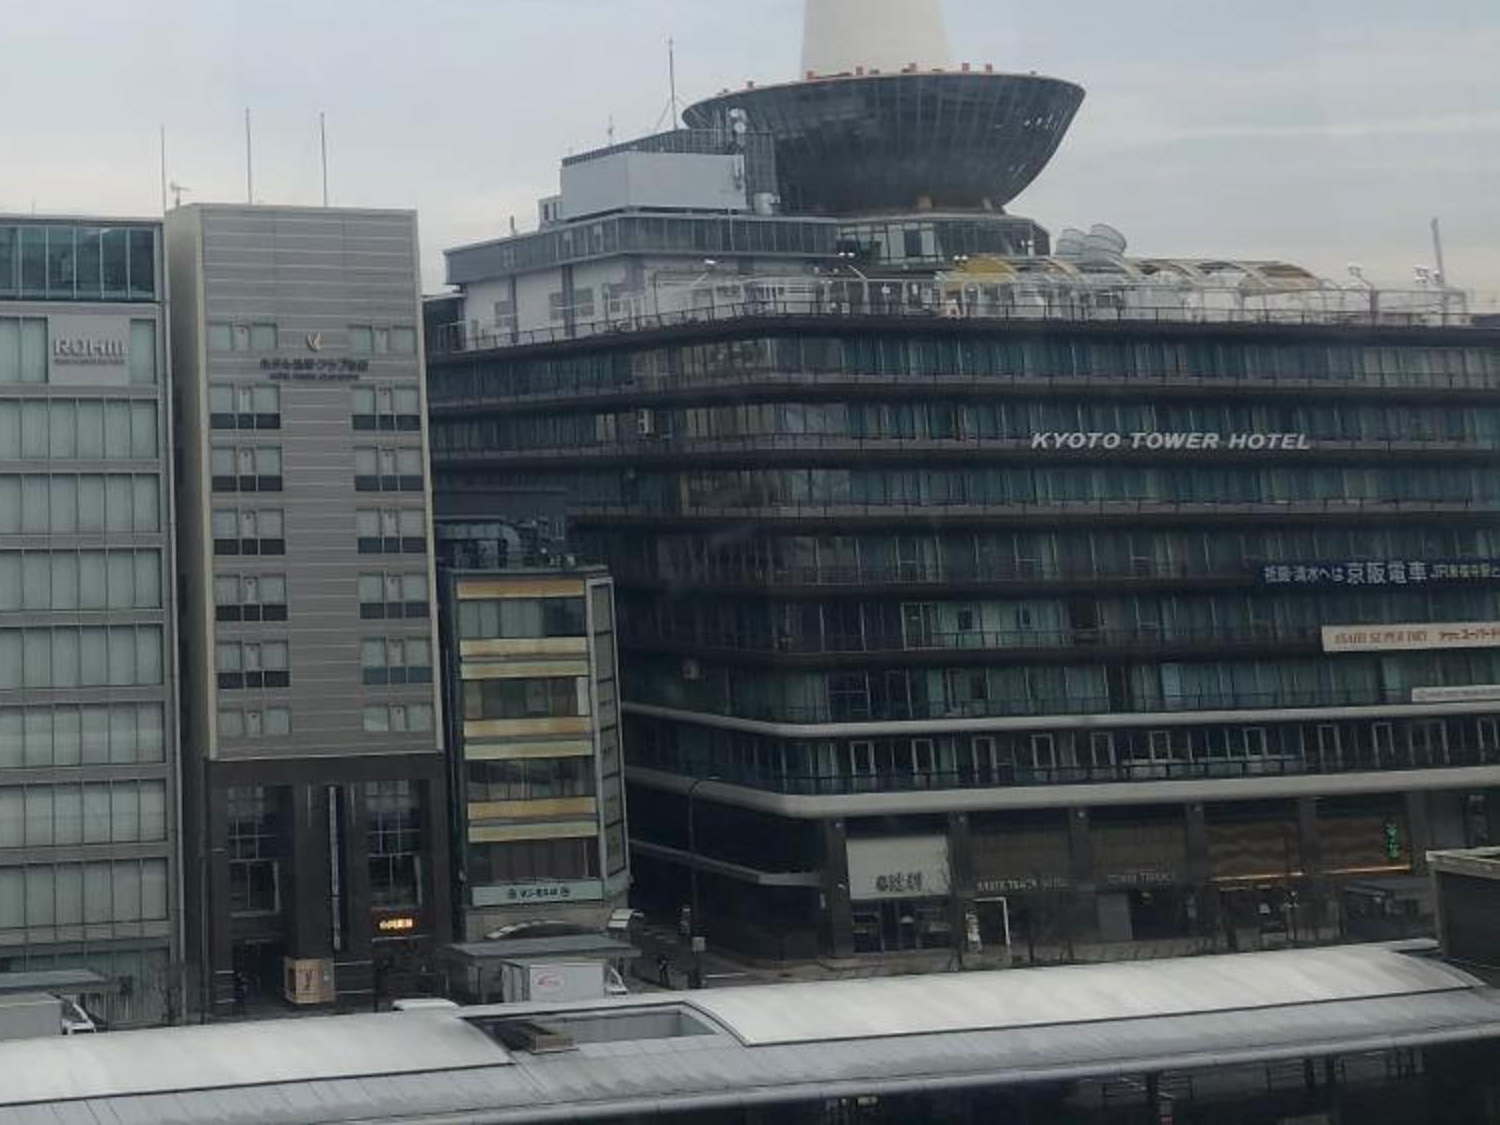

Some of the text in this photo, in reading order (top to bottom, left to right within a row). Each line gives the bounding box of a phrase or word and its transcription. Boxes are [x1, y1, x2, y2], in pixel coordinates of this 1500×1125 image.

[53, 337, 124, 356] ROHM
[1031, 432, 1311, 451] KYOTO TOWER HOTEL
[1347, 561, 1428, 584] 京阪電車
